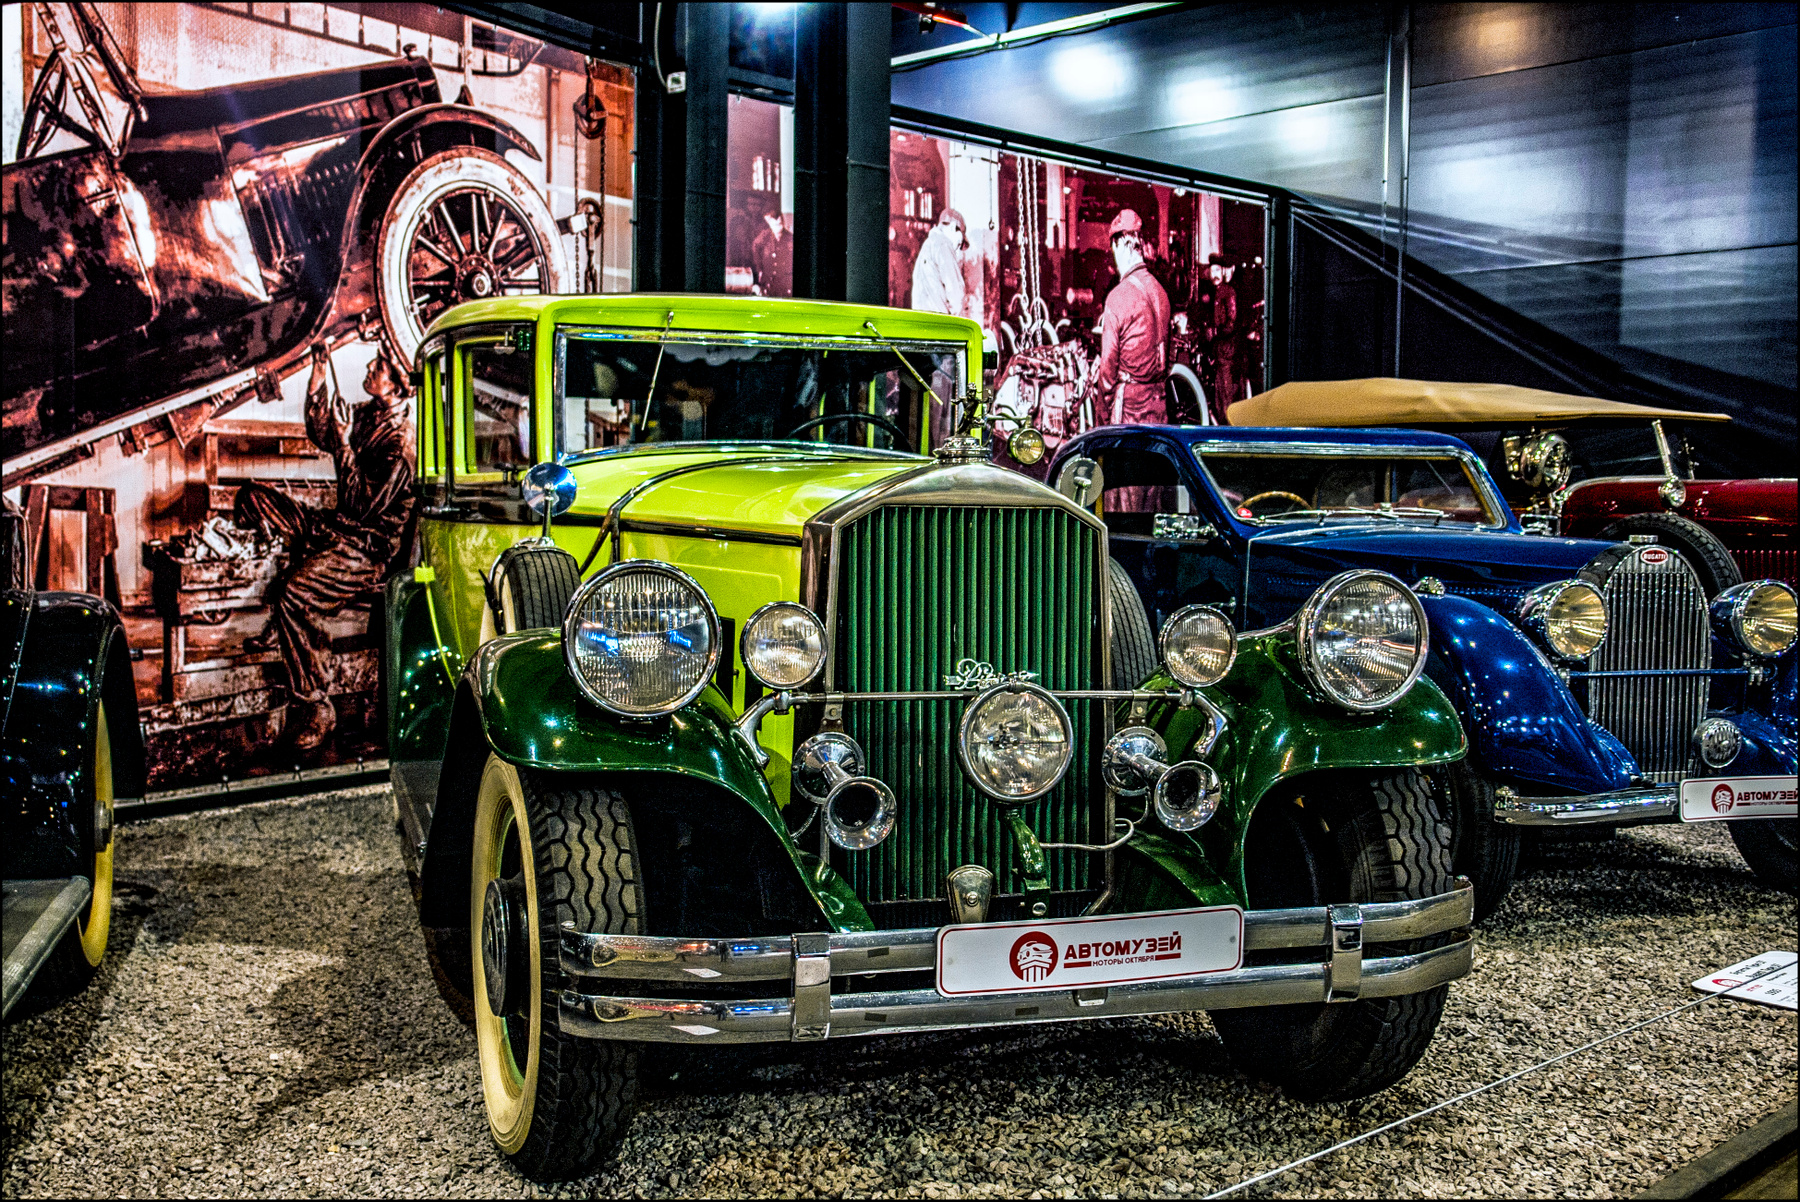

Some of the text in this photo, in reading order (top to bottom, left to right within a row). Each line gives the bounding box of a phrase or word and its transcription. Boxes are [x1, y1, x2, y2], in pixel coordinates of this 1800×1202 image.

[1063, 930, 1182, 960] АВТОМУЗЕЙ
[1092, 955, 1154, 967] МОТОРЫ ОКТЯБРЯ
